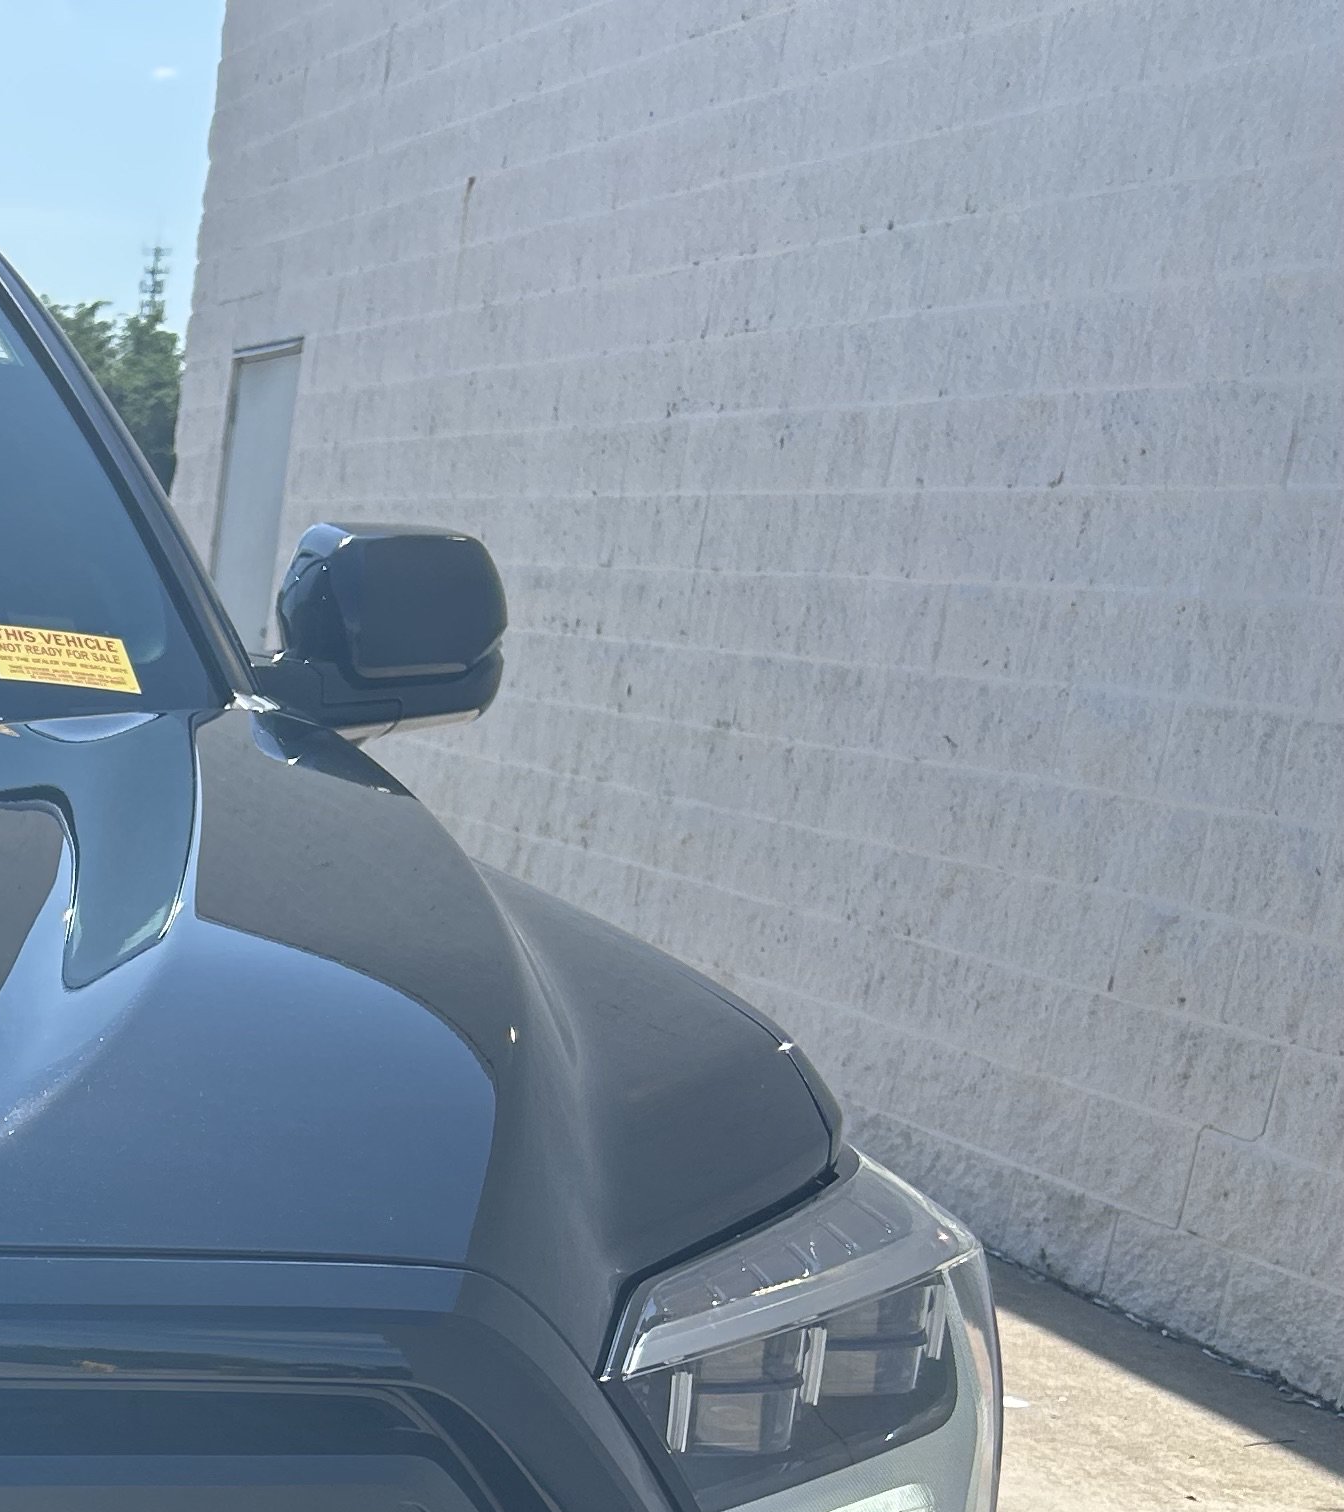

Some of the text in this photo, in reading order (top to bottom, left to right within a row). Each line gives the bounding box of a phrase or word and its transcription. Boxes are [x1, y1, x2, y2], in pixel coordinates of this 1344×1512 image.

[38, 631, 119, 653] VEHICLE
[25, 645, 62, 658] READY
[65, 649, 90, 661] FOR
[91, 652, 122, 665] SALE
